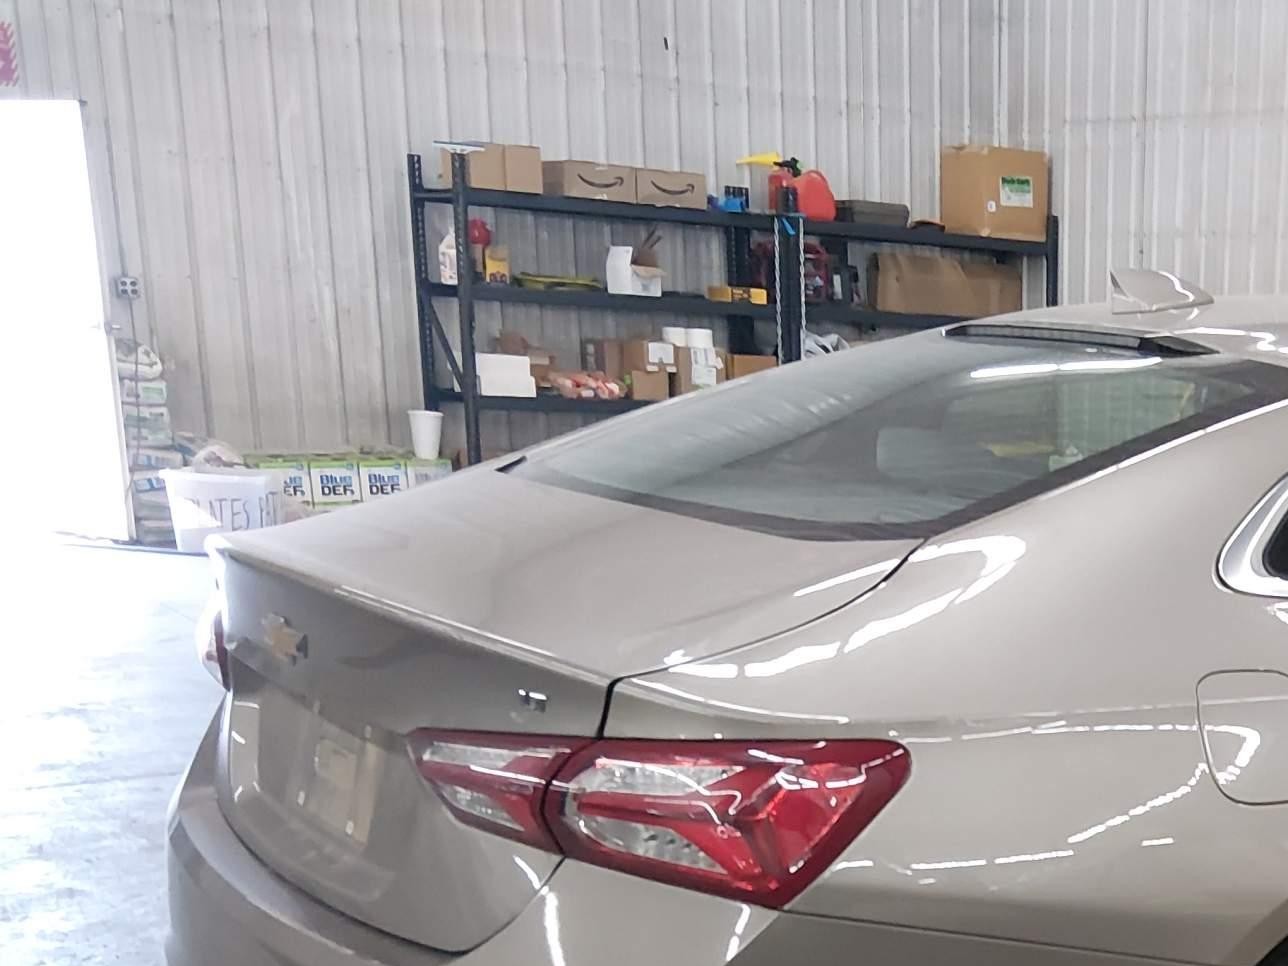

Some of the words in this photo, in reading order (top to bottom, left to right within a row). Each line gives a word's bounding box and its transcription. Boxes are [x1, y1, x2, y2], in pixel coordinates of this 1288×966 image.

[319, 474, 353, 486] Blue
[368, 473, 400, 485] Blue
[321, 485, 355, 497] DEF
